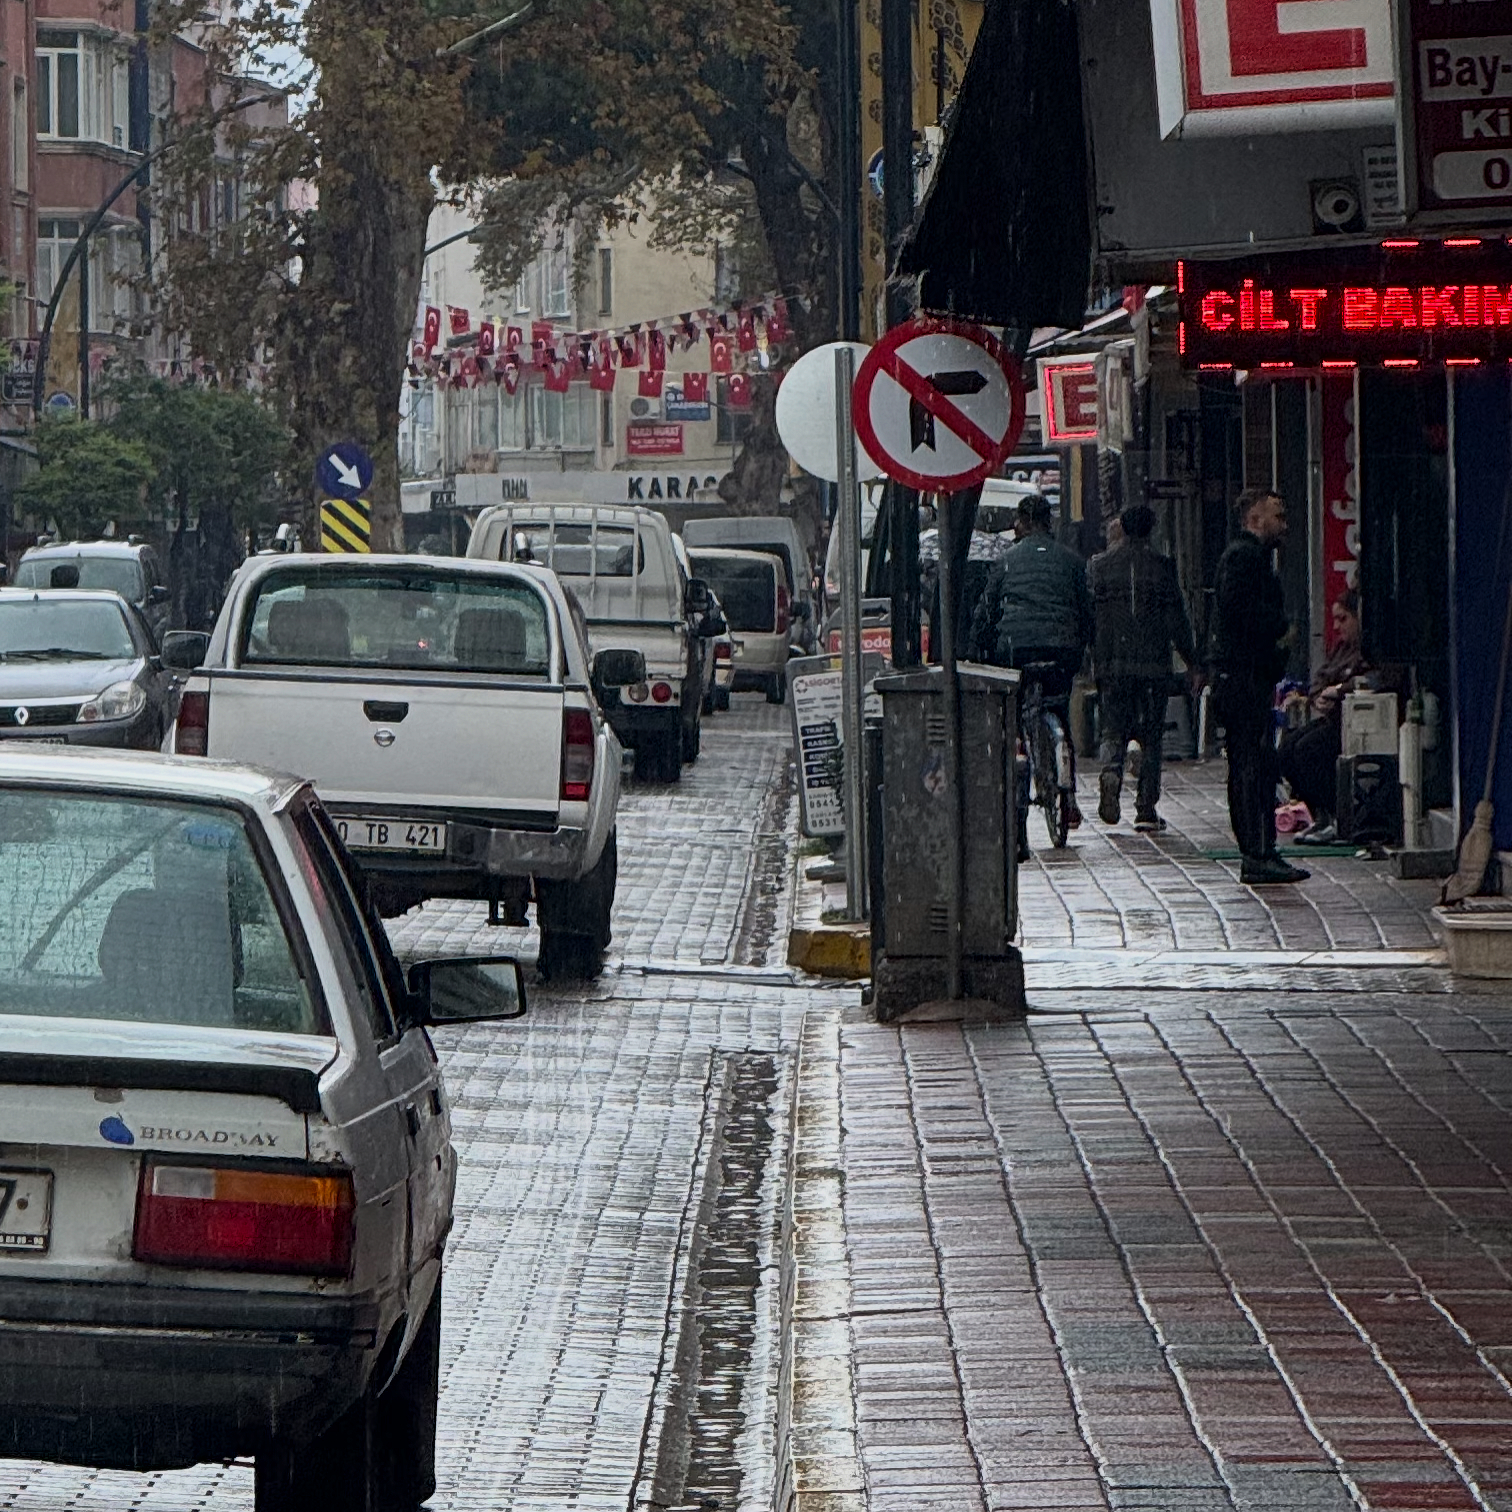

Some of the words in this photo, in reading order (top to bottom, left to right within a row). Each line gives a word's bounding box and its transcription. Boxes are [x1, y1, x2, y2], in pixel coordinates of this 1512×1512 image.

[1201, 279, 1328, 331] CİLT
[365, 823, 389, 845] TB
[405, 825, 439, 848] 421
